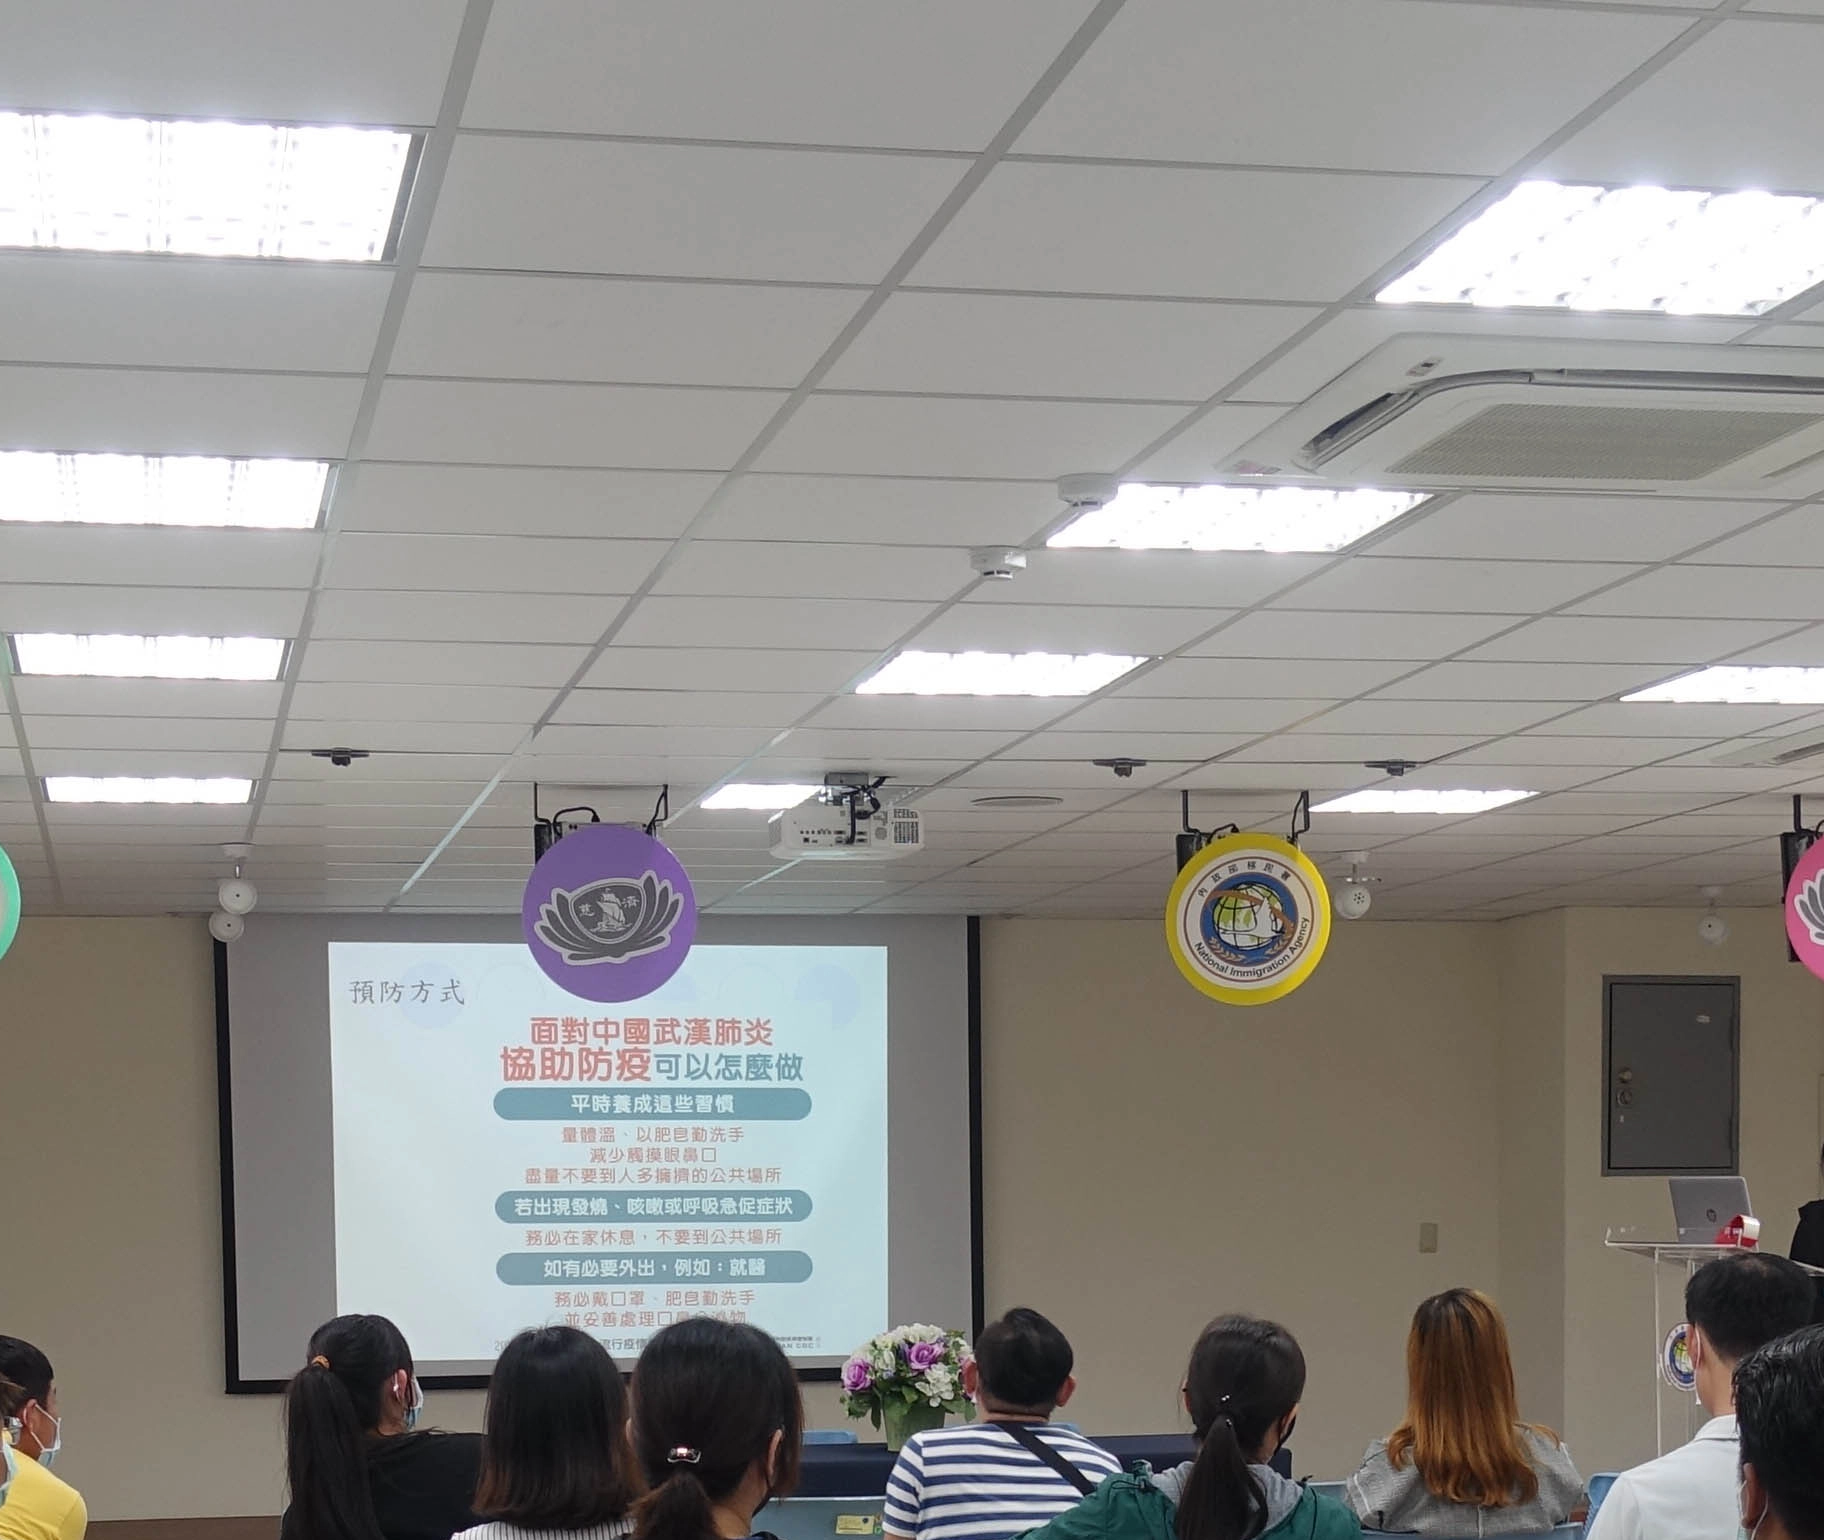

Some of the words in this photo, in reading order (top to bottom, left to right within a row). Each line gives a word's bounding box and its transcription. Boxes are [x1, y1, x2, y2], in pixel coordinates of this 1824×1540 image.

[1194, 942, 1229, 974] National
[1230, 954, 1290, 978] Immigration
[1290, 917, 1311, 955] Agency
[349, 979, 464, 1005] 預防方式
[530, 1016, 774, 1046] 面對中國武漢肺炎
[500, 1046, 804, 1082] 協助防疫可以怎麼做
[571, 1094, 735, 1114] 平時養成這些習慣
[590, 1147, 717, 1163] 減少觸摸眼鼻口
